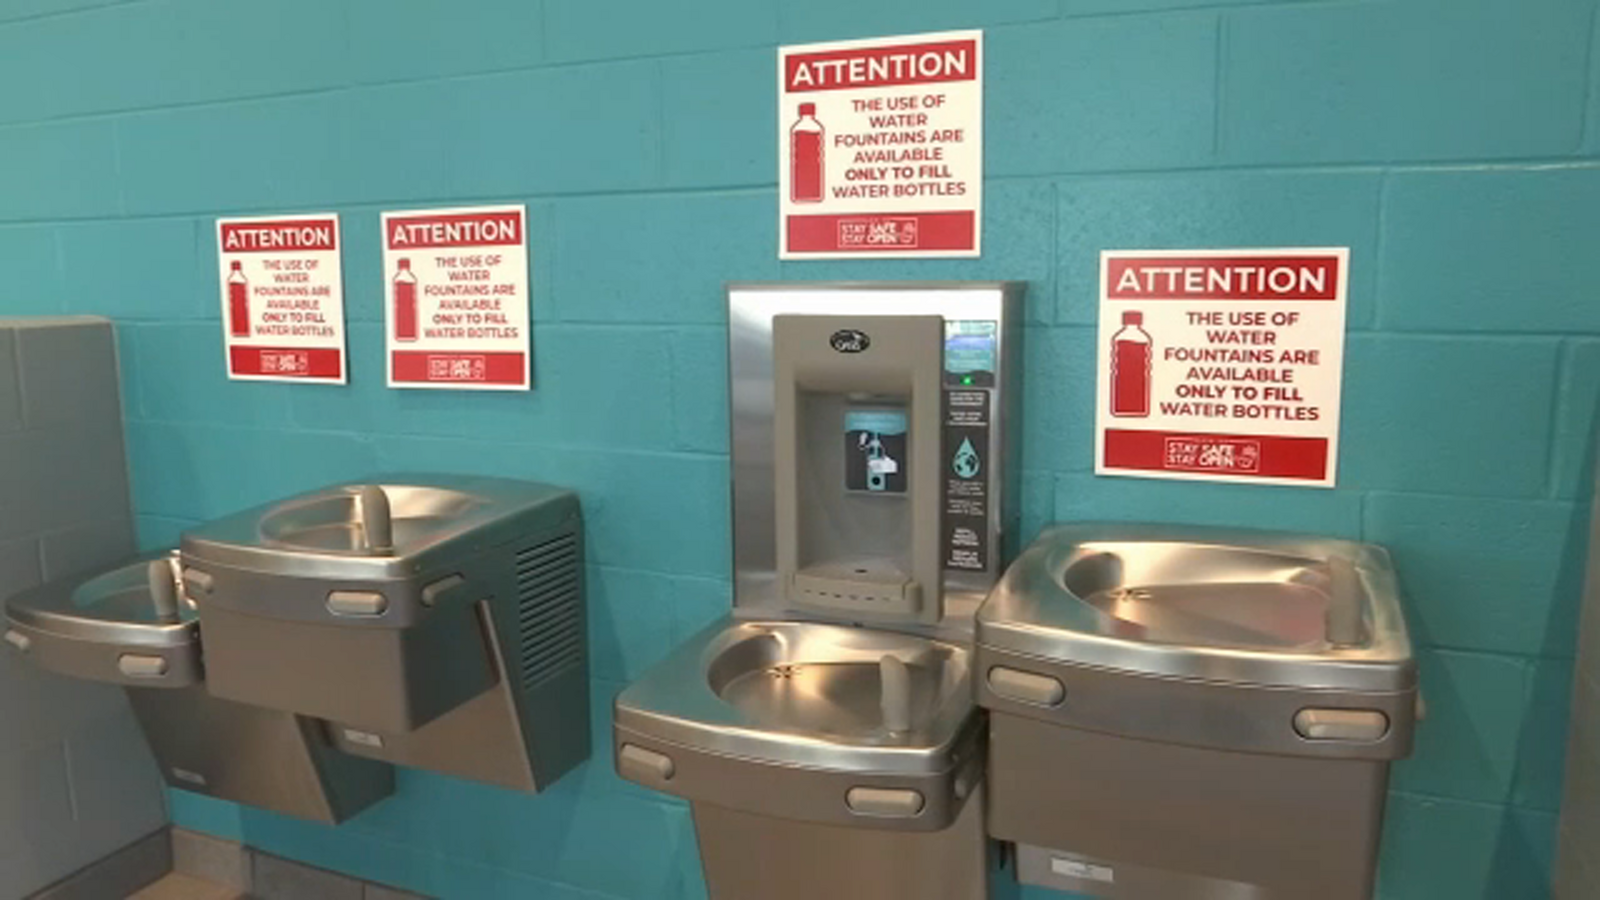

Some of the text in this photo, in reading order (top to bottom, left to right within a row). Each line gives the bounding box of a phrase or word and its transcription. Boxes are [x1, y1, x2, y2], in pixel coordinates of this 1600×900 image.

[792, 50, 966, 86] ATTENTION
[851, 94, 946, 112] THE USE OF
[869, 113, 928, 128] WATER
[834, 129, 964, 148] FOUNTAINS ARE
[853, 147, 944, 164] AVAILABLE
[844, 164, 952, 181] ONLY TO FILL
[832, 182, 966, 198] WATER BOTTLES
[226, 227, 330, 248] ATTENTION
[392, 220, 514, 244] ATTENTION
[262, 260, 318, 270] THE USE OF
[435, 255, 502, 268] THE USE OF
[273, 272, 310, 282] WATER
[448, 270, 490, 281] WATER
[1116, 267, 1326, 292] ATTENTION
[254, 286, 330, 296] FOUNTAINS ARE
[424, 284, 516, 296] FOUNTAINS ARE
[266, 300, 320, 310] AVAILABLE
[438, 299, 501, 310] AVAILABLE
[262, 312, 326, 323] ONLY TO FILL
[432, 314, 508, 324] ONLY TO FILL
[1186, 312, 1300, 326] THE USE OF
[255, 325, 335, 336] WATER BOTTLES
[424, 327, 518, 338] WATER BOTTLES
[1206, 330, 1276, 346] WATER
[1164, 348, 1320, 364] FOUNTAINS ARE
[1186, 367, 1294, 382] AVAILABLE
[1175, 384, 1304, 402] ONLY TO FILL
[1159, 402, 1320, 420] WATER BOTTLES
